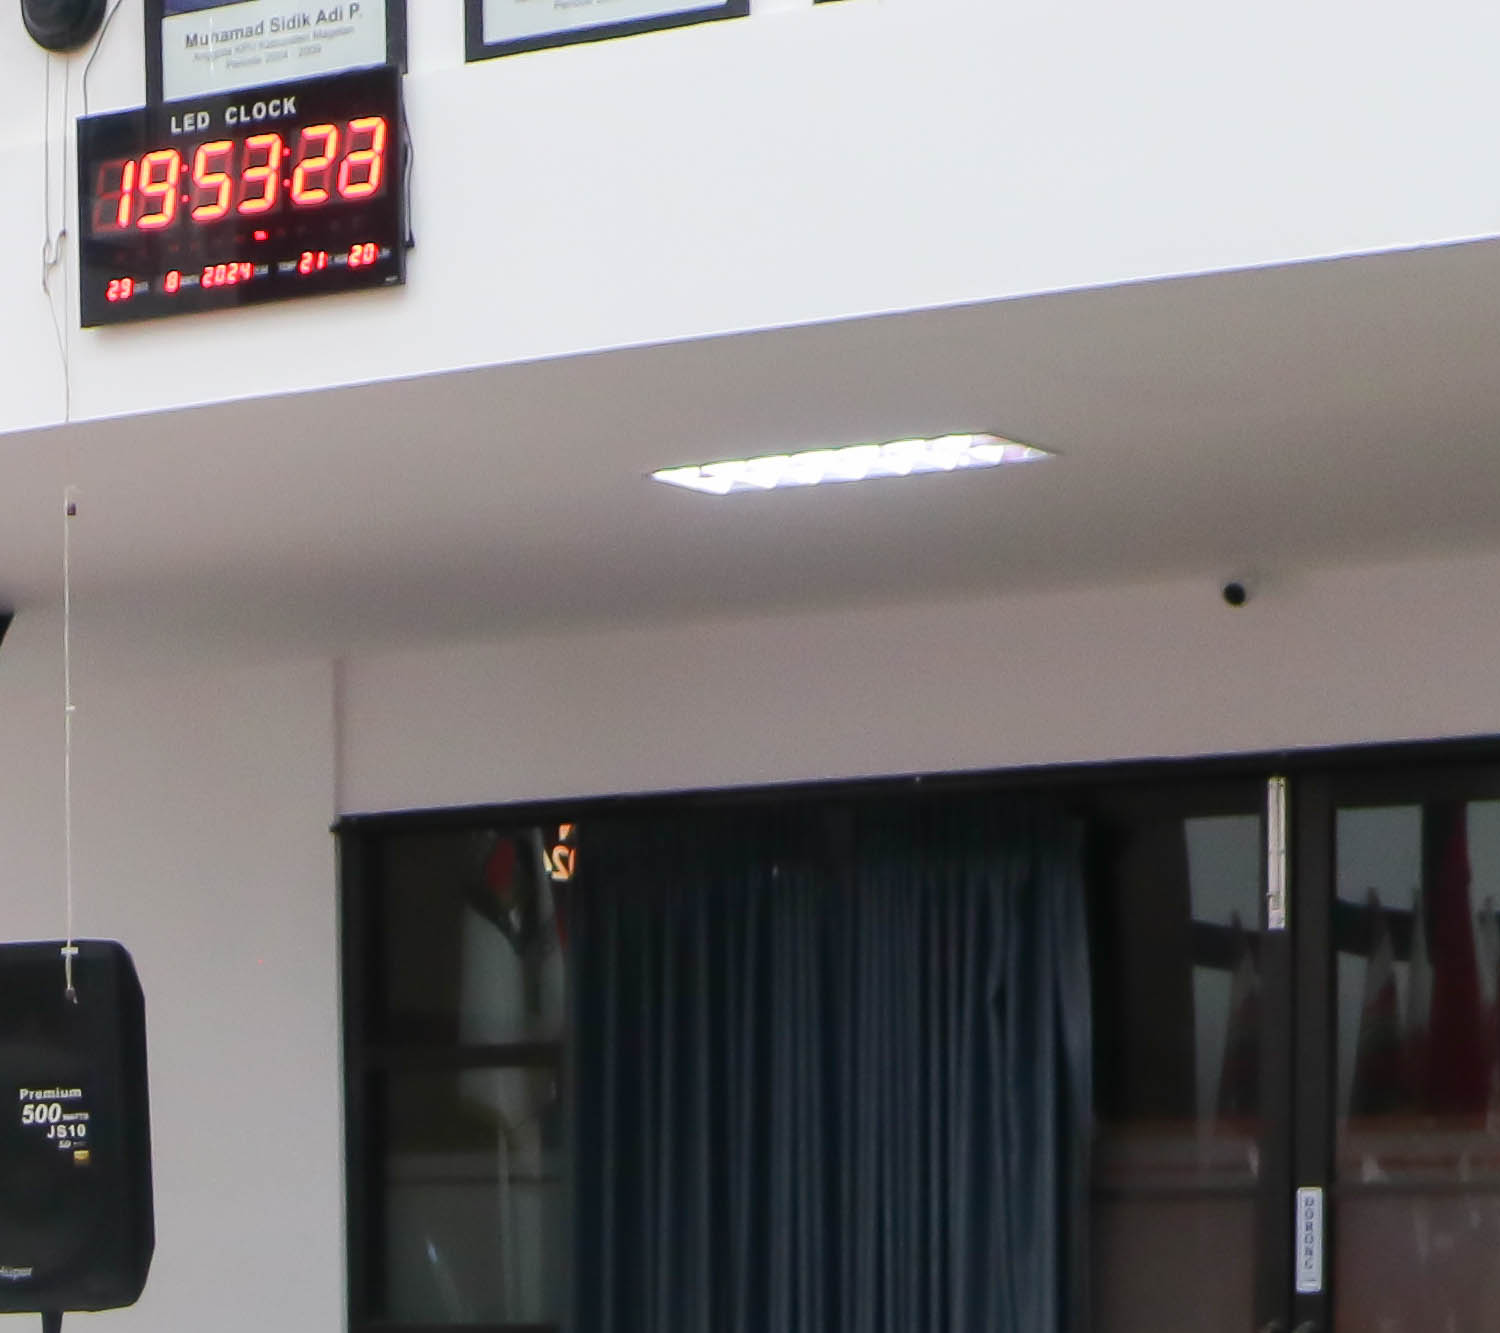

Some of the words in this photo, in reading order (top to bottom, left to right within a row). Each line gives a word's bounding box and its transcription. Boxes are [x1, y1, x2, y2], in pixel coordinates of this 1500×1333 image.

[270, 11, 310, 33] Sidik
[316, 6, 343, 25] Adi
[170, 112, 210, 134] LED
[225, 96, 297, 125] CLOCK
[201, 261, 253, 288] 2024
[299, 251, 328, 275] 21
[348, 242, 380, 268] 20
[19, 1087, 82, 1100] Premium
[22, 1103, 62, 1124] 500
[47, 1124, 87, 1138] JS10
